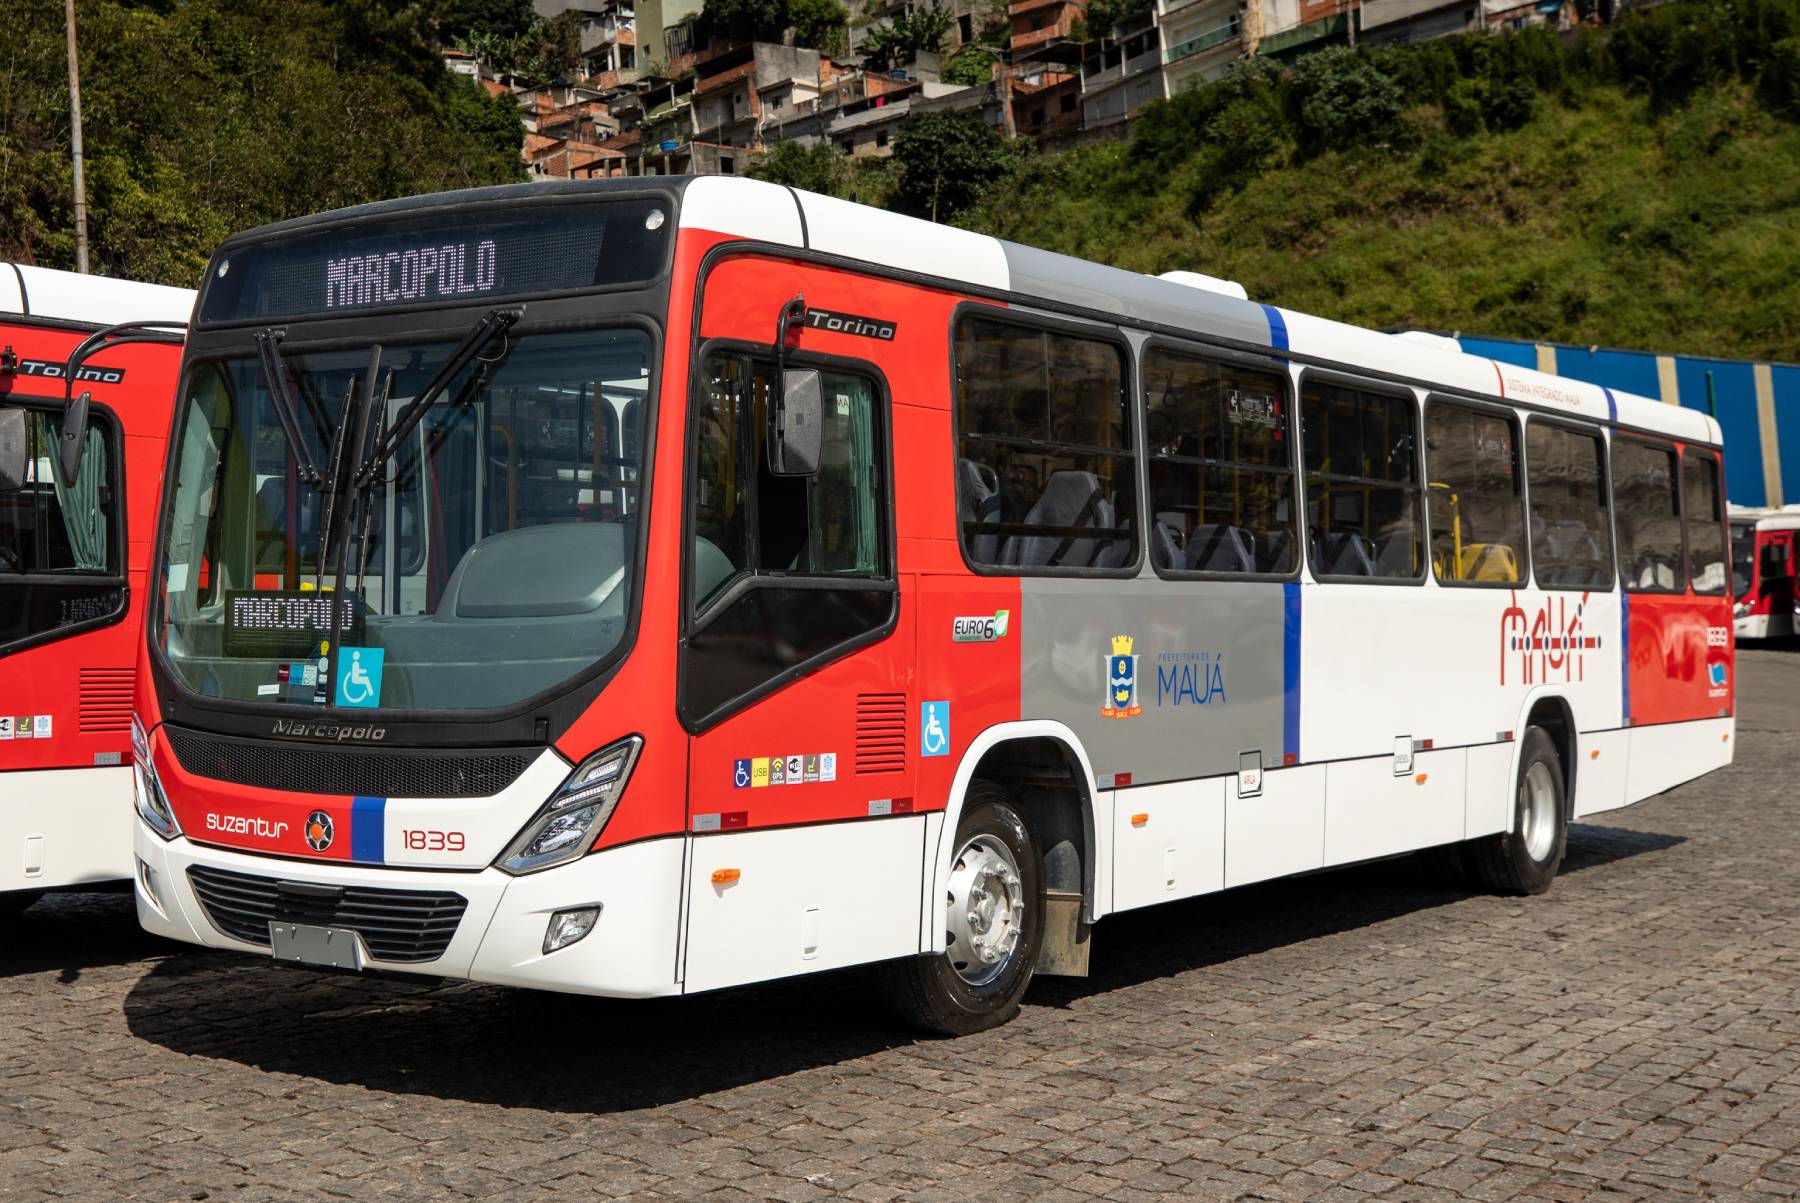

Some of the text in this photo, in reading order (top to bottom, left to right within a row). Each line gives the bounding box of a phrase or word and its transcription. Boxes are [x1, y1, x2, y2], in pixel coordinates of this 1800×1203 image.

[326, 240, 496, 307] MARCOPOLO
[808, 310, 894, 339] Torino
[22, 361, 121, 382] Toino
[1158, 653, 1226, 707] MAUÁ
[272, 719, 386, 740] Marcopolo
[753, 768, 767, 777] USB
[772, 772, 783, 780] GPS
[206, 812, 289, 838] suzantur
[402, 829, 465, 851] 1839
